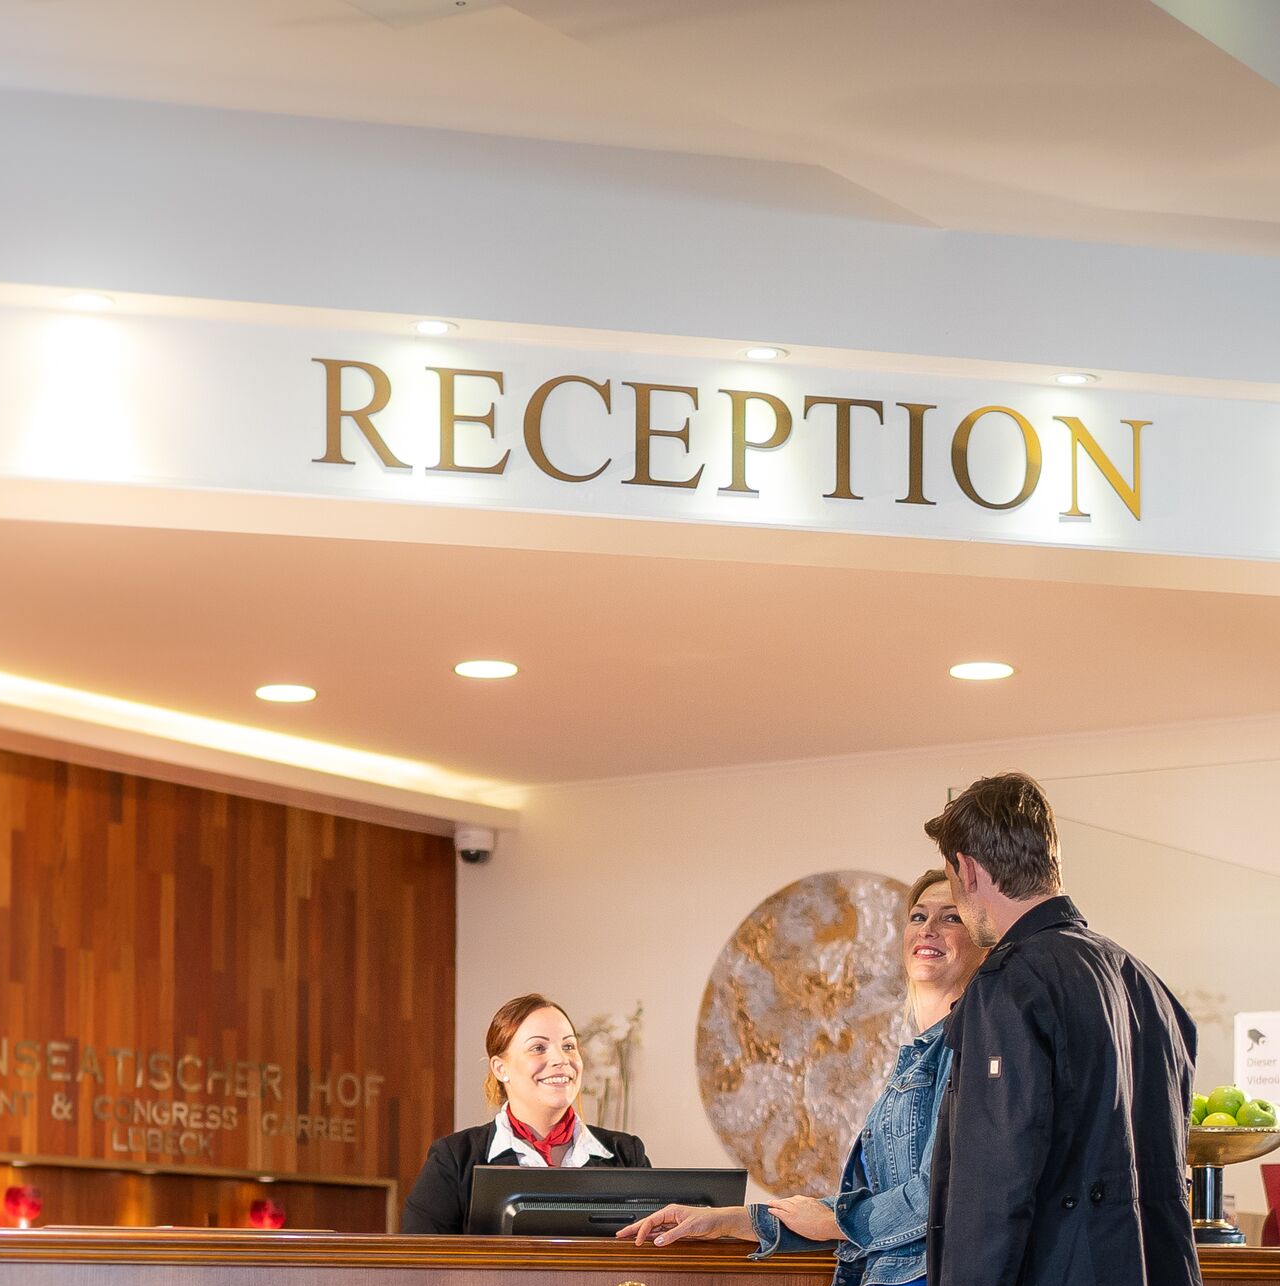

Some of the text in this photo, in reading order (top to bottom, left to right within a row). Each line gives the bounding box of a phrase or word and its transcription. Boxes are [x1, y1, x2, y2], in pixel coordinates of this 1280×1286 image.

[310, 357, 1154, 522] RECEPTION
[1246, 1056, 1278, 1067] Dieser
[309, 1070, 386, 1107] HOF
[51, 1092, 73, 1120] &
[92, 1094, 238, 1130] CONGRESS
